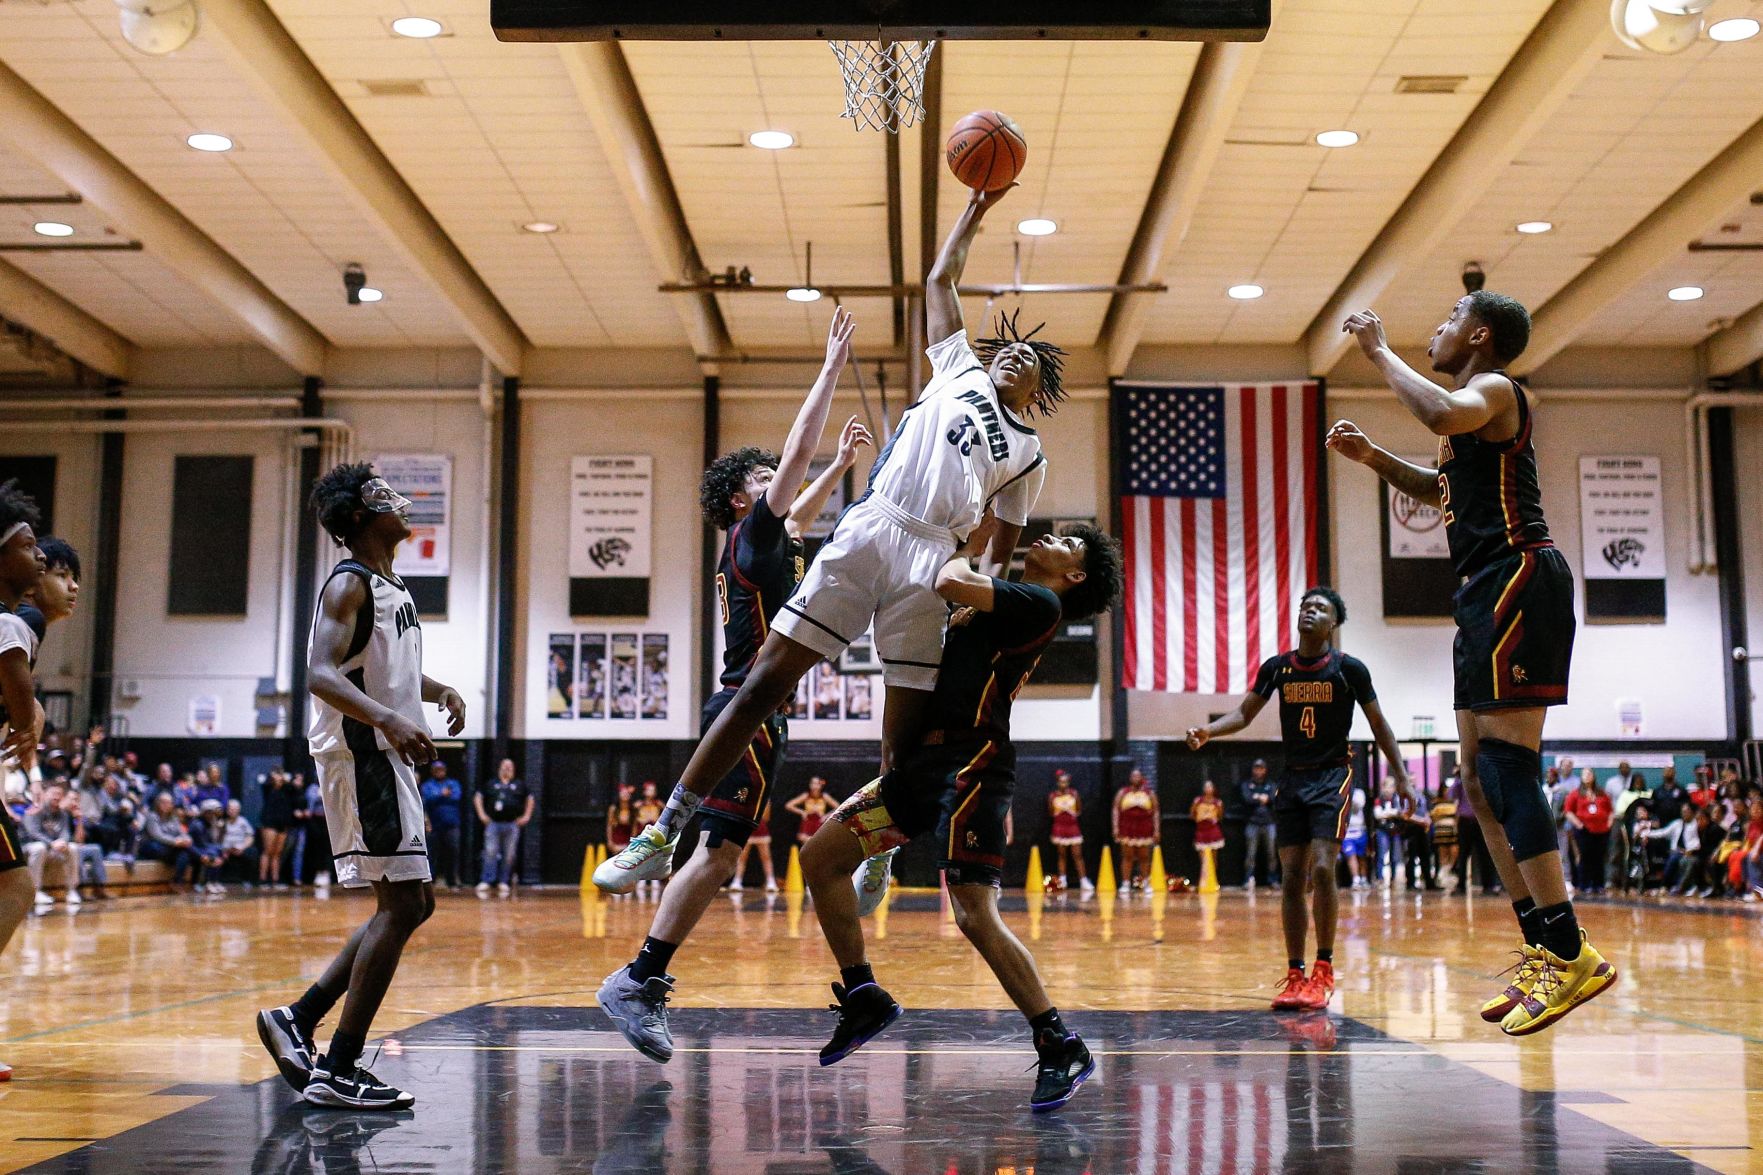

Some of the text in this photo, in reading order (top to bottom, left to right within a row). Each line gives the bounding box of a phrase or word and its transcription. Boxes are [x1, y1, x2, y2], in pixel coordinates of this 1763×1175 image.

[946, 413, 982, 457] 33
[1283, 681, 1333, 703] SIERRA
[1300, 706, 1316, 739] 4
